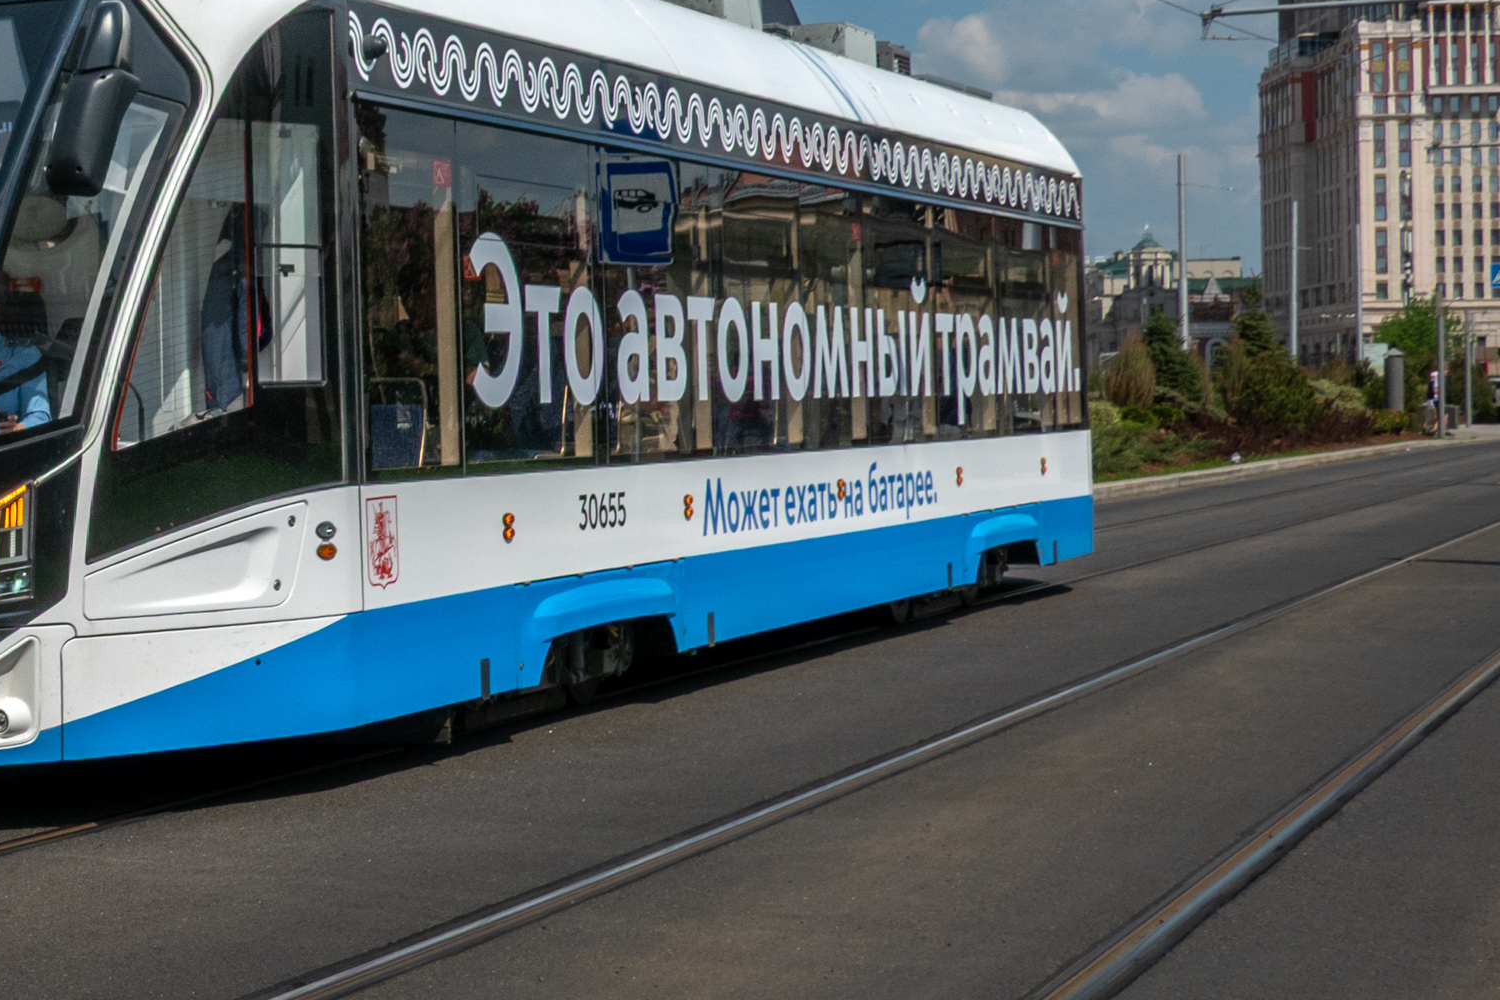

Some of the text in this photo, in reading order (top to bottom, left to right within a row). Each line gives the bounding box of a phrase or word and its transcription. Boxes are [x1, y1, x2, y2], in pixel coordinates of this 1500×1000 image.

[468, 231, 1081, 426] Это автономный трамвай.
[578, 491, 627, 531] 30655
[703, 461, 938, 536] Может ехать на батарее.
